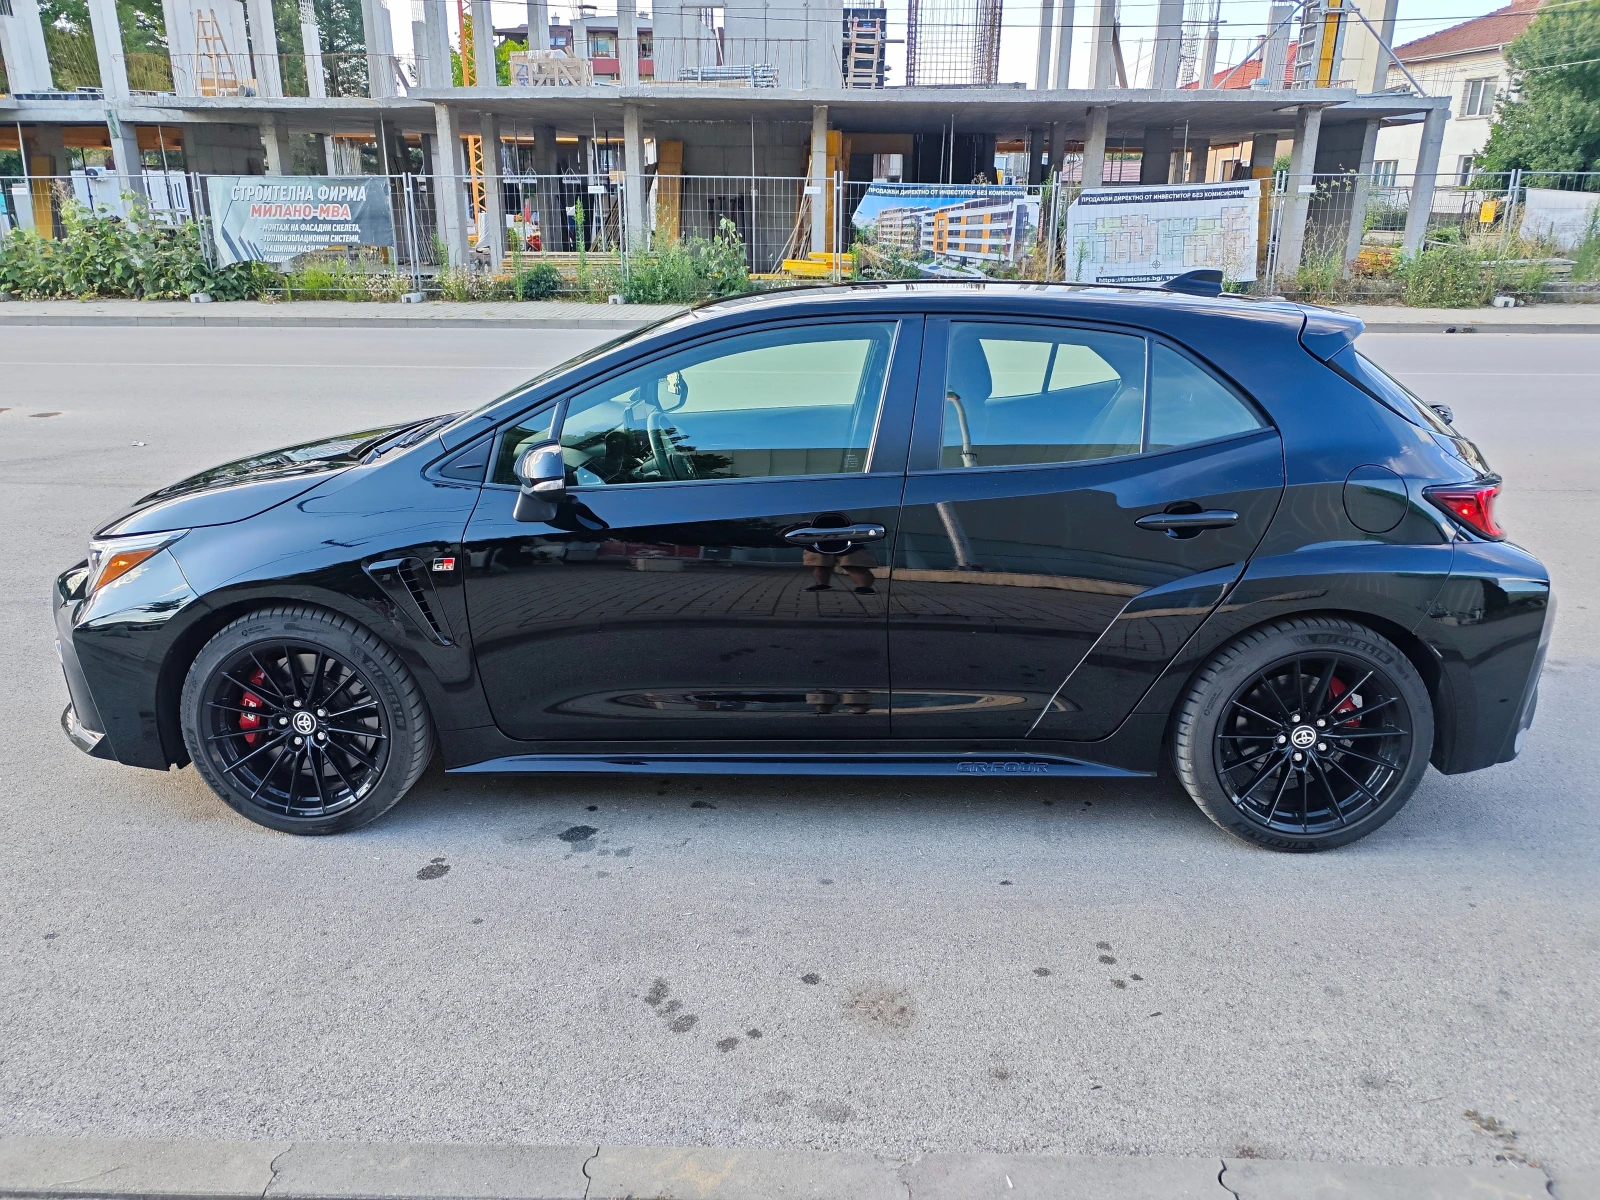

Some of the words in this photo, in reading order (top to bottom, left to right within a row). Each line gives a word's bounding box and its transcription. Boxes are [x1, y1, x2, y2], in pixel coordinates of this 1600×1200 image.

[231, 185, 314, 202] СТРОИТЕЛНА
[317, 184, 366, 202] ФИРМА
[868, 187, 899, 195] ПРОДАЖБИ
[1113, 194, 1144, 202] ДИРЕКТНО
[1153, 192, 1191, 200] ИНВЕСТИТОР
[250, 203, 351, 219] МИЛАНО-МВА
[291, 223, 299, 232] НА
[300, 223, 331, 234] ФАСАДНИ
[332, 224, 361, 233] СКЕЛЕТА,
[330, 234, 361, 243] СИСТЕМИ,
[433, 561, 454, 571] GR
[1315, 634, 1390, 663] MICHELIN
[365, 660, 406, 729] MICHELIN
